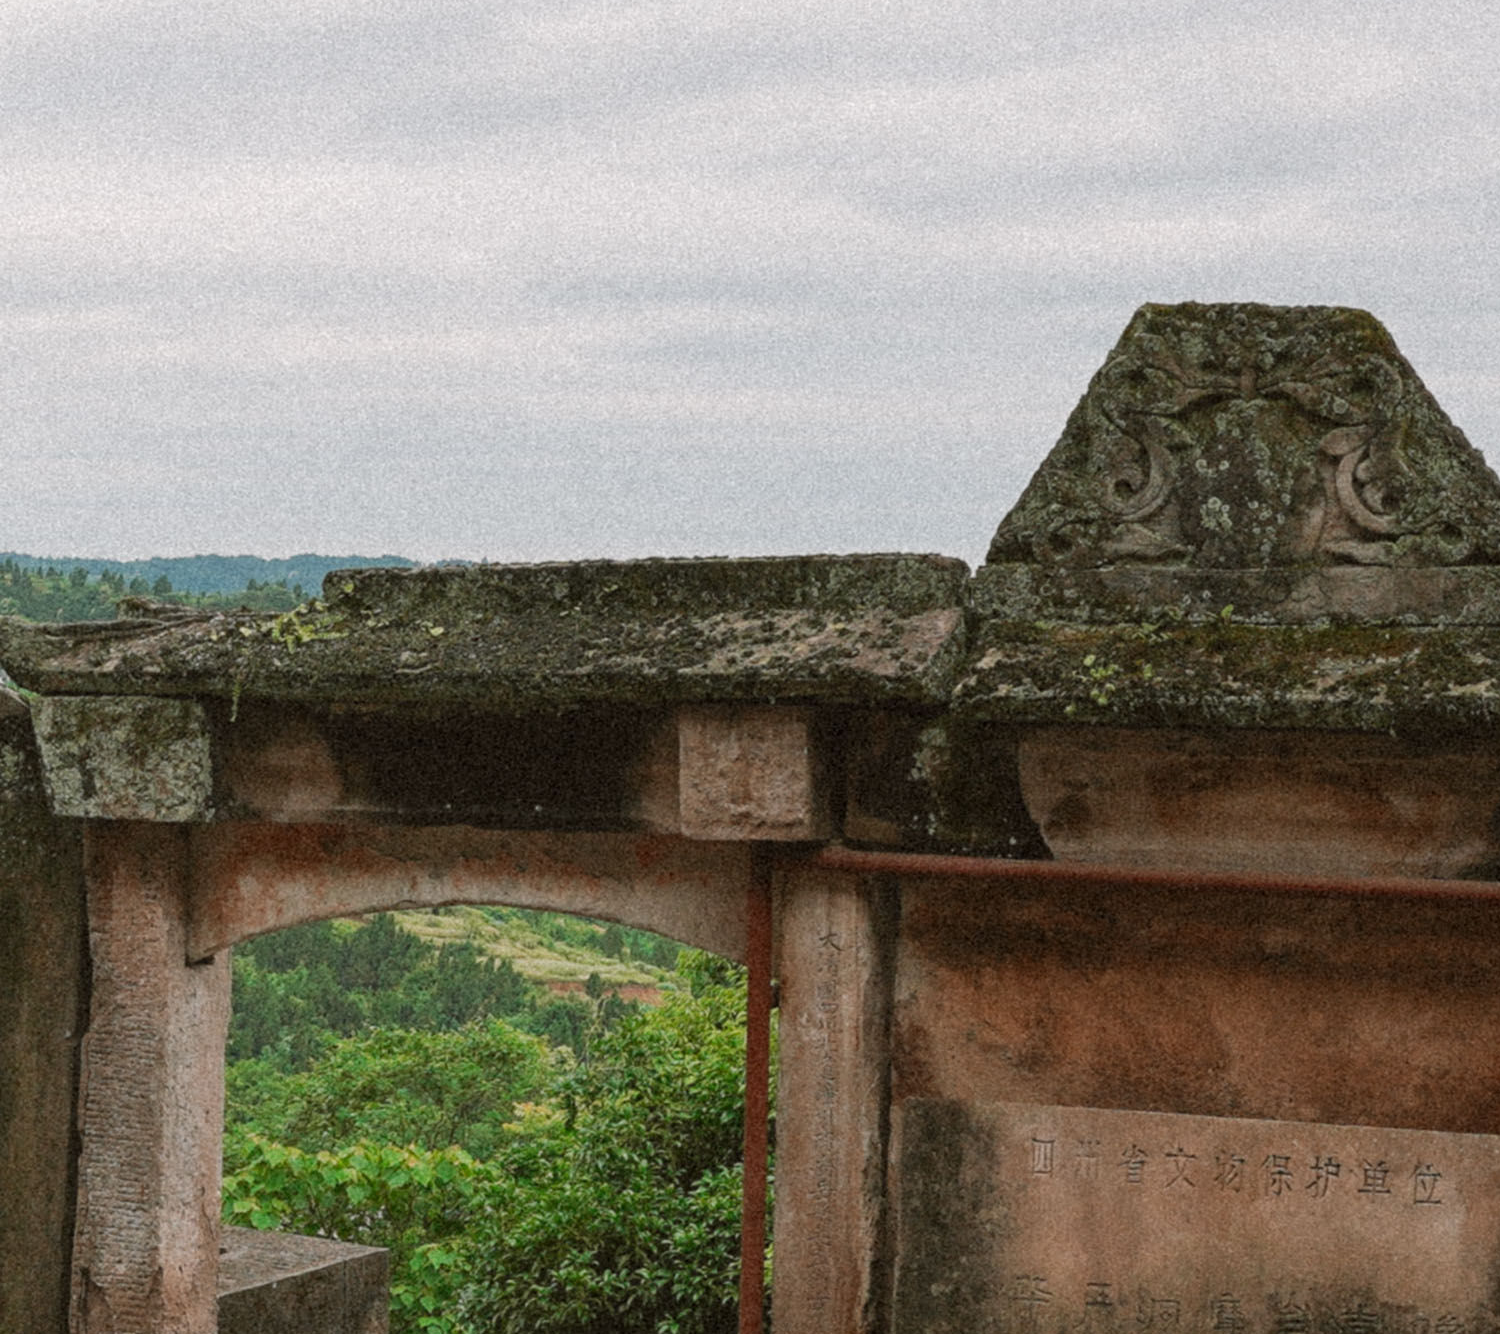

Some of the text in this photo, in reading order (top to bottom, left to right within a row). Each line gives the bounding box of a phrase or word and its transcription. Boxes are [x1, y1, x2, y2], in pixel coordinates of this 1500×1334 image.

[1029, 1135, 1445, 1207] 四川省文物保护单位
